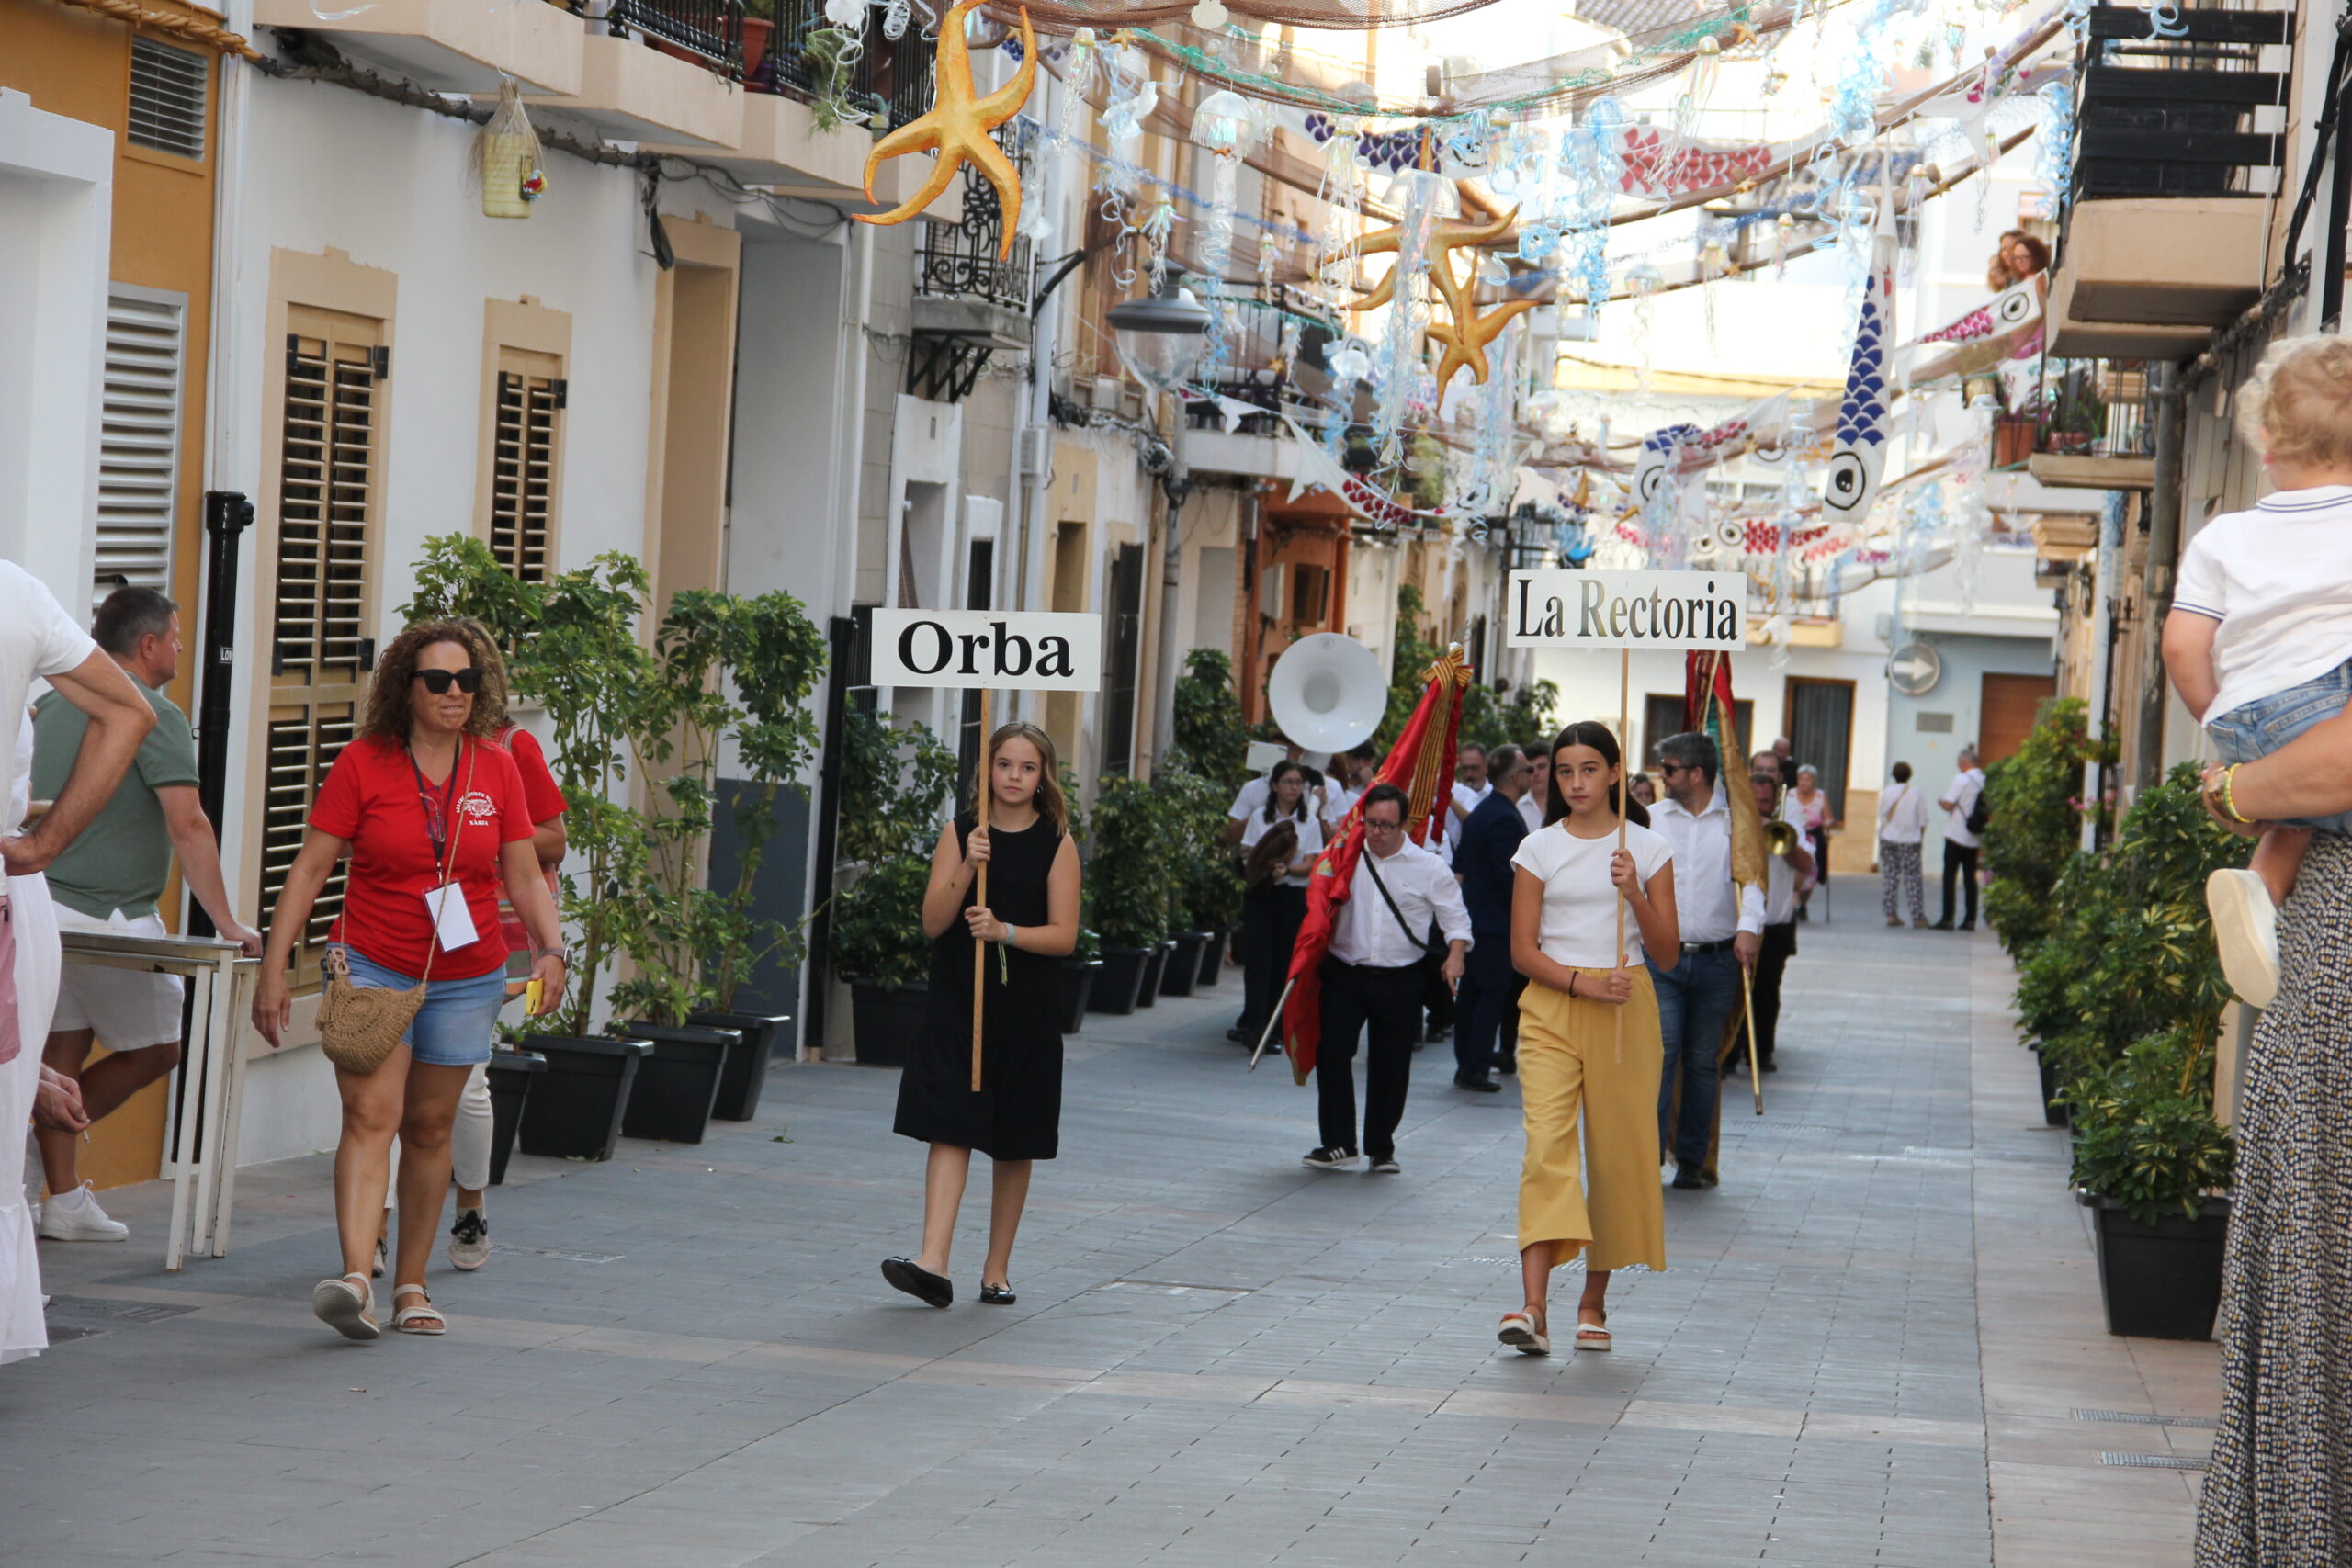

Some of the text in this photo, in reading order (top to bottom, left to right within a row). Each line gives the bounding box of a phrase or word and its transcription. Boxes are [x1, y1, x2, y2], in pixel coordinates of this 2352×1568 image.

[1515, 579, 1738, 641] La Rectoria
[898, 620, 1074, 678] Orba
